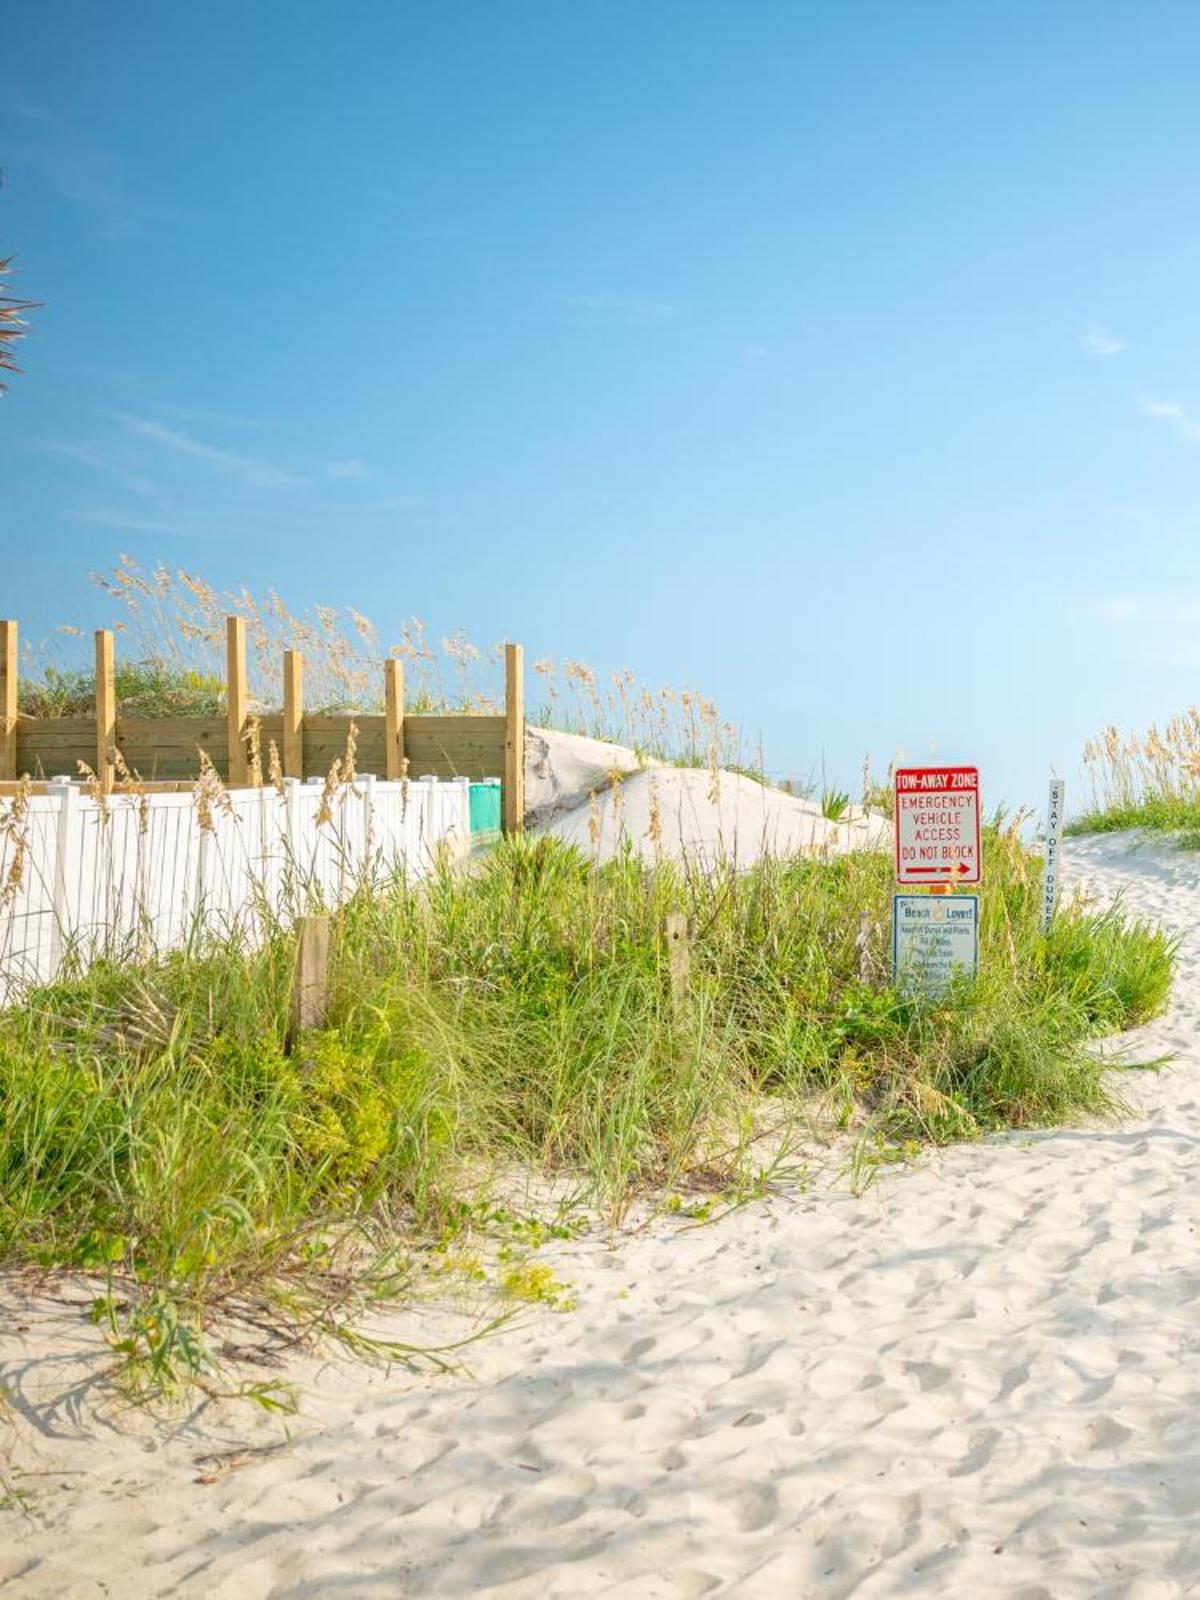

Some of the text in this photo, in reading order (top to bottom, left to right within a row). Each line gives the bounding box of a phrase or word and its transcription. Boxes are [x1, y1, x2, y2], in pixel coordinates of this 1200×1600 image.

[897, 773, 978, 790] TOW-AWAY ZONE
[902, 796, 972, 809] EMERGENCY
[913, 812, 961, 825] VEHICLE
[914, 828, 960, 841] ACCESS
[902, 845, 974, 860] DO NOT BLOCK
[1048, 838, 1057, 865] OFF
[905, 907, 930, 918] Beach
